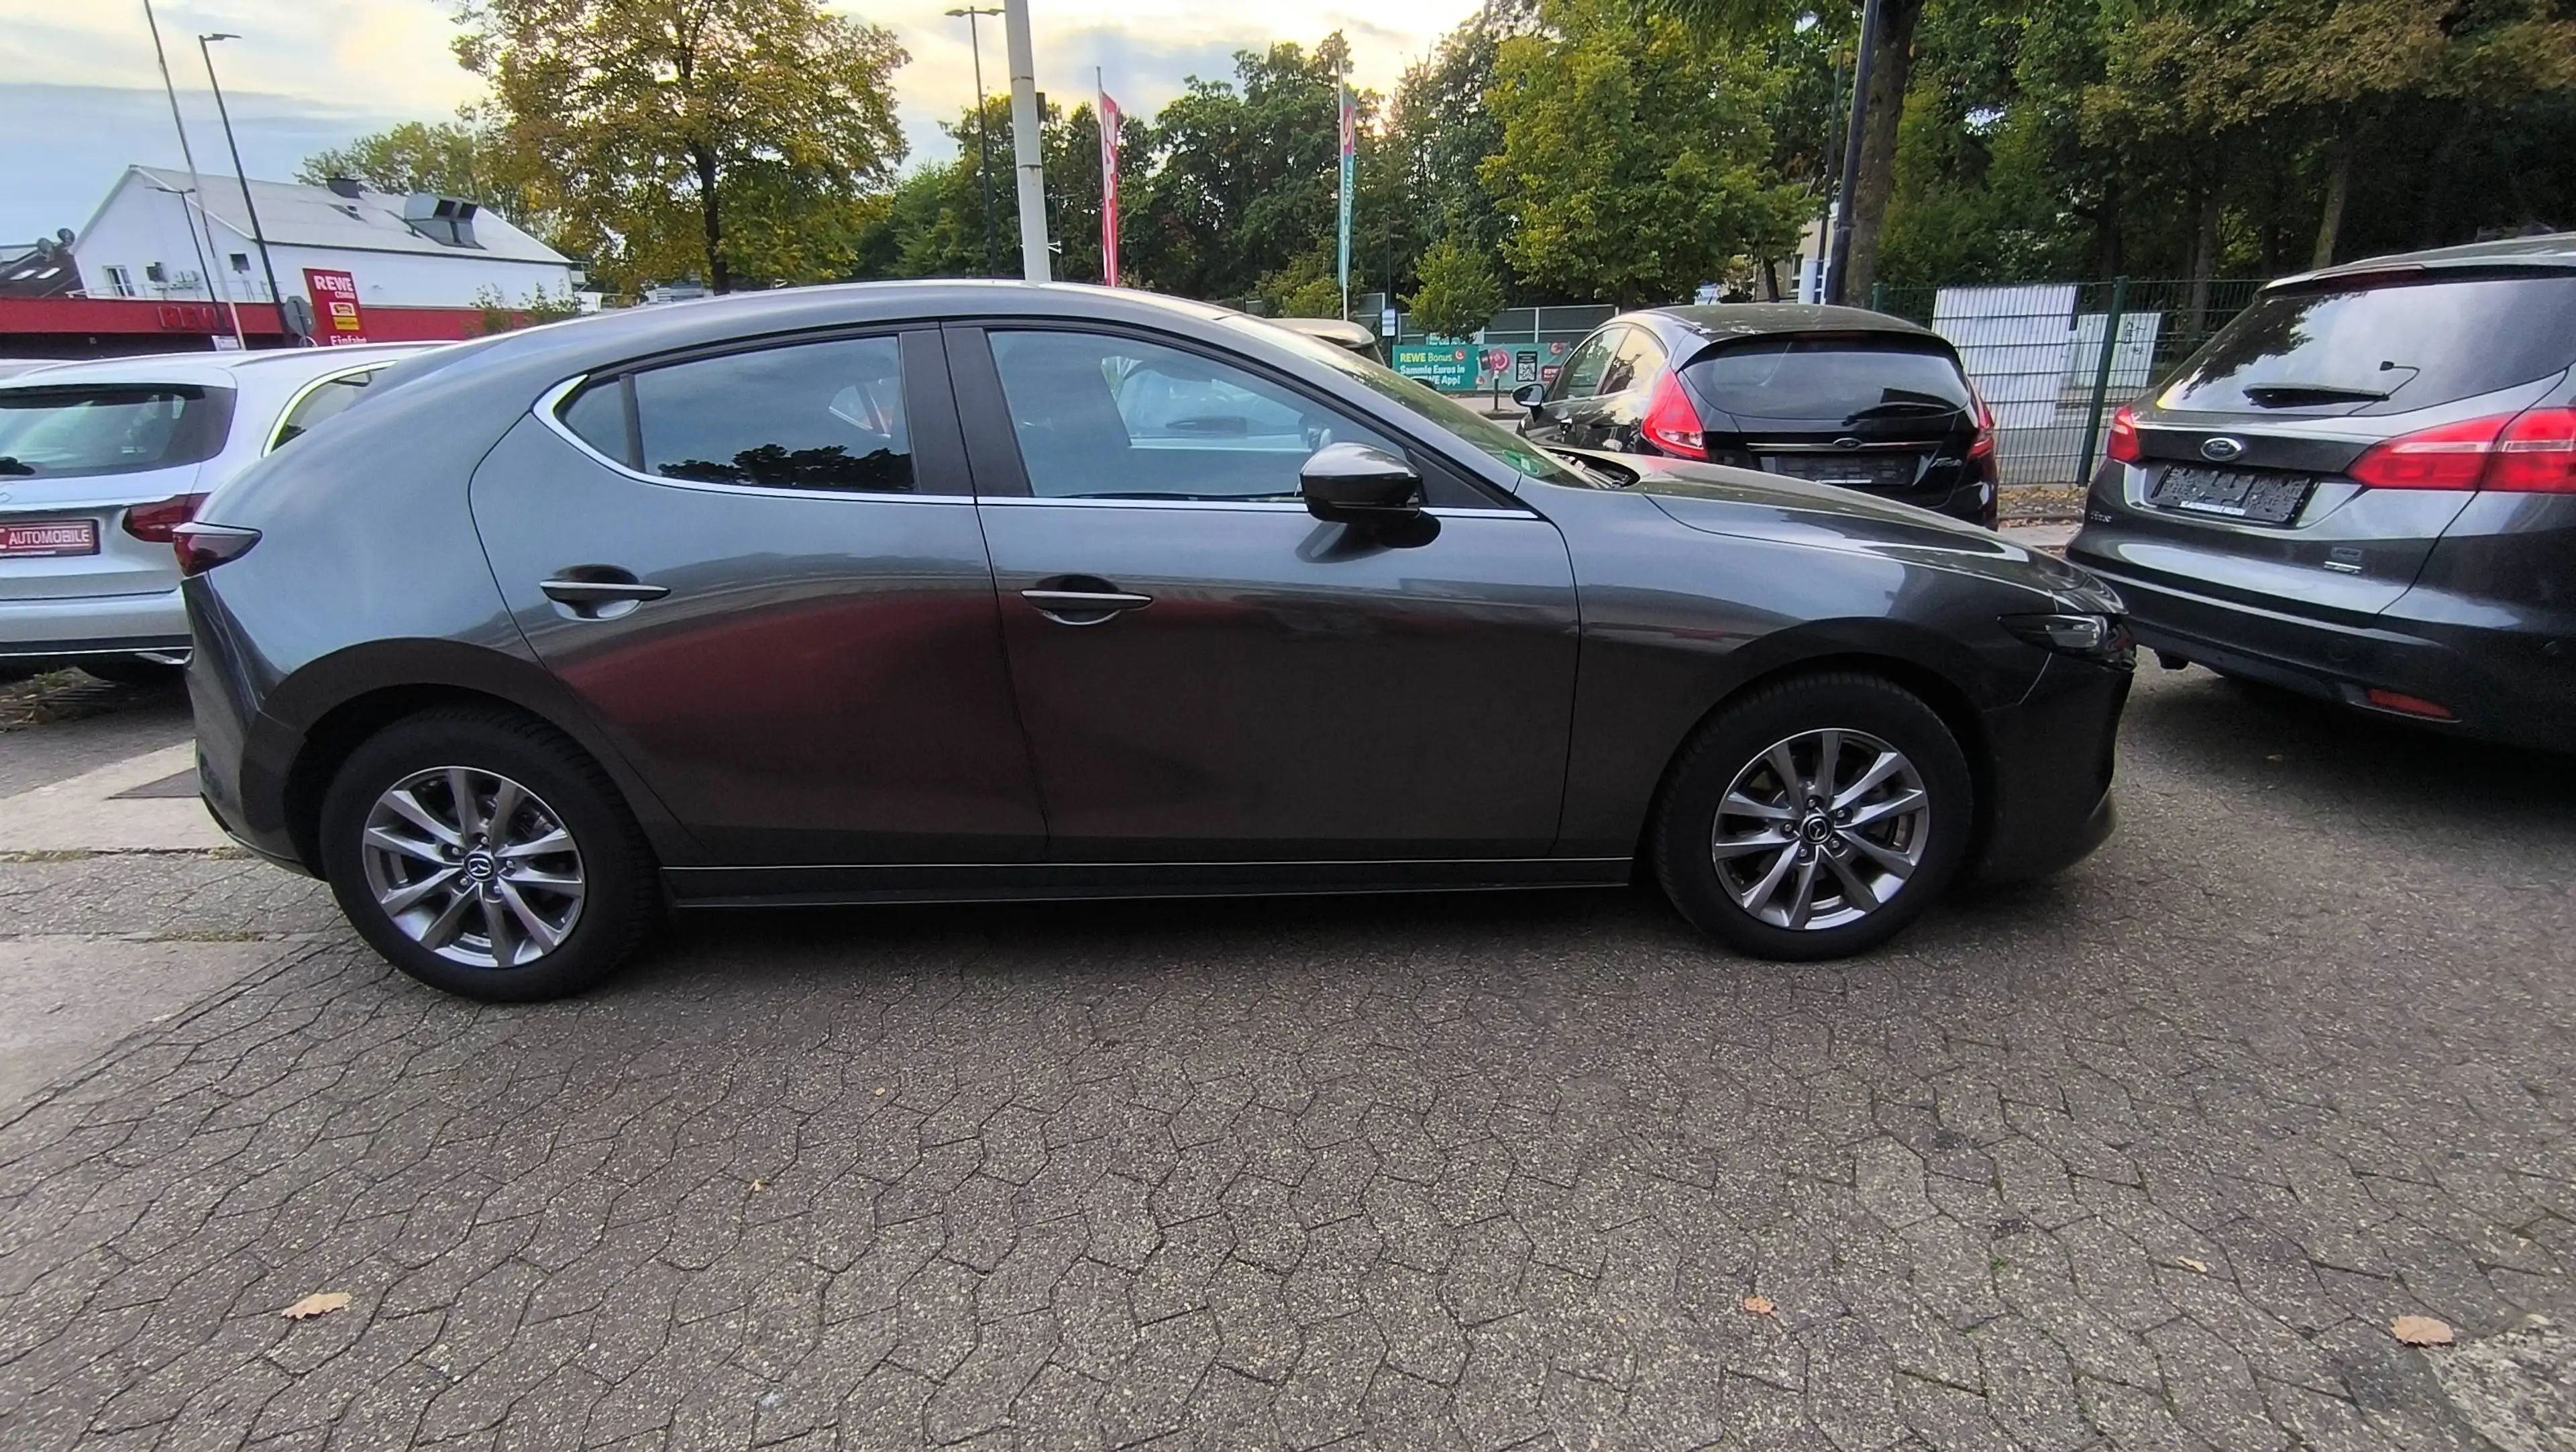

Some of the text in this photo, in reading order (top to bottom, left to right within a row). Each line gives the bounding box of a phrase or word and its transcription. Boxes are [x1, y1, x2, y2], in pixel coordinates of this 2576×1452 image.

[313, 275, 354, 292] REWE
[1400, 352, 1452, 362] REWE Bonus
[1400, 364, 1465, 375] Sammle Euros in
[1441, 374, 1461, 386] App!
[8, 529, 91, 545] AUTOMOBILE
